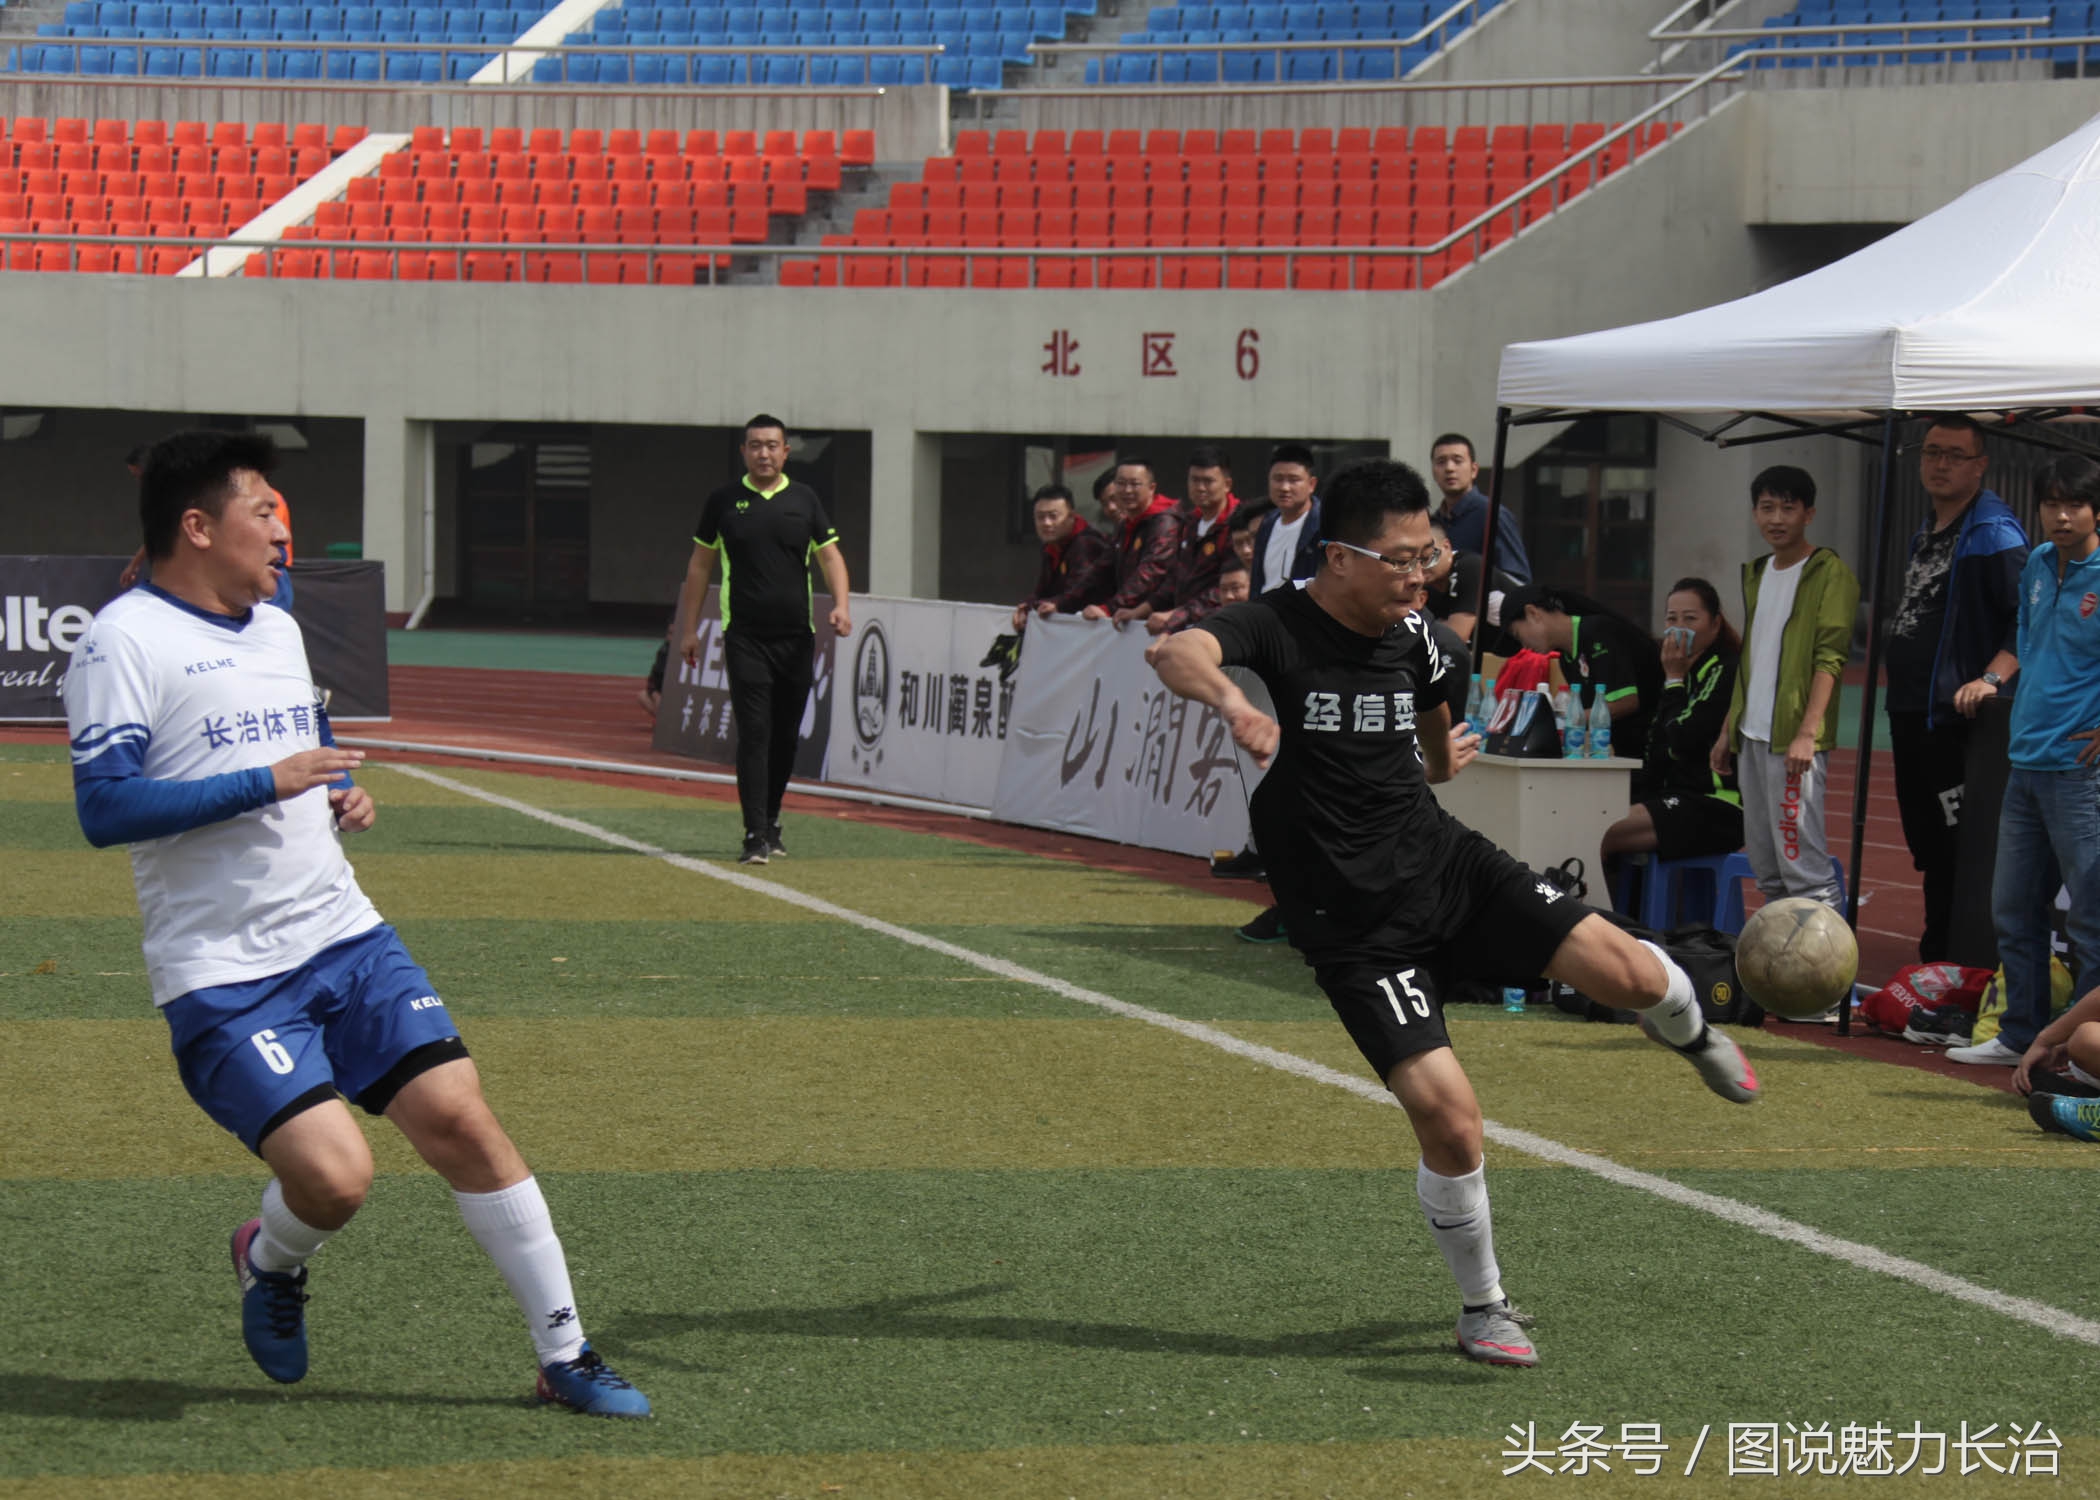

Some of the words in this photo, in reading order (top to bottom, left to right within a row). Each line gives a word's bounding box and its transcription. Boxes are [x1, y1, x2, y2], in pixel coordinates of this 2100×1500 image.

[0, 595, 94, 653] lte
[184, 657, 237, 676] KELME
[1376, 969, 1430, 1025] 15
[251, 1028, 294, 1075] 6
